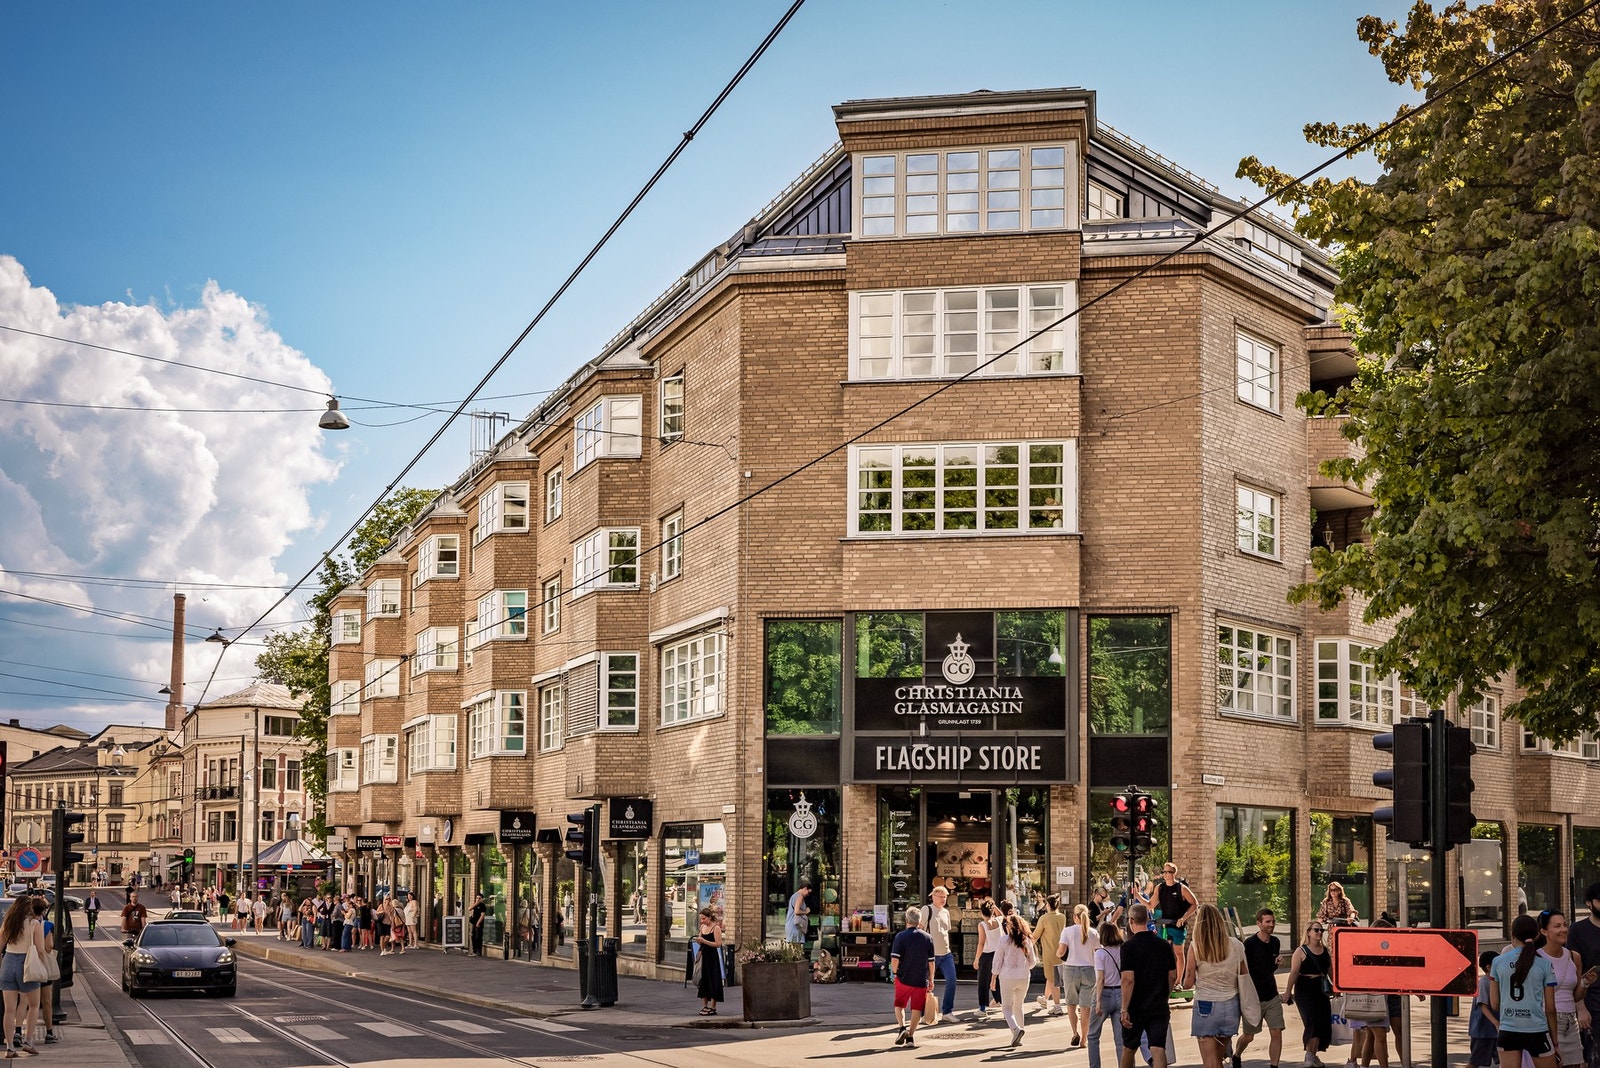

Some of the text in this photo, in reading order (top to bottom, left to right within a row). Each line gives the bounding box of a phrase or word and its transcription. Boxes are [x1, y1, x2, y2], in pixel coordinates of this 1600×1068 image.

[947, 662, 970, 675] CG
[894, 686, 1024, 699] CHRISTIANIA
[894, 701, 1023, 715] GLASMAGASIN
[875, 745, 1041, 770] FLAGSHIP STORE
[793, 819, 813, 830] CG
[210, 852, 229, 861] LETT
